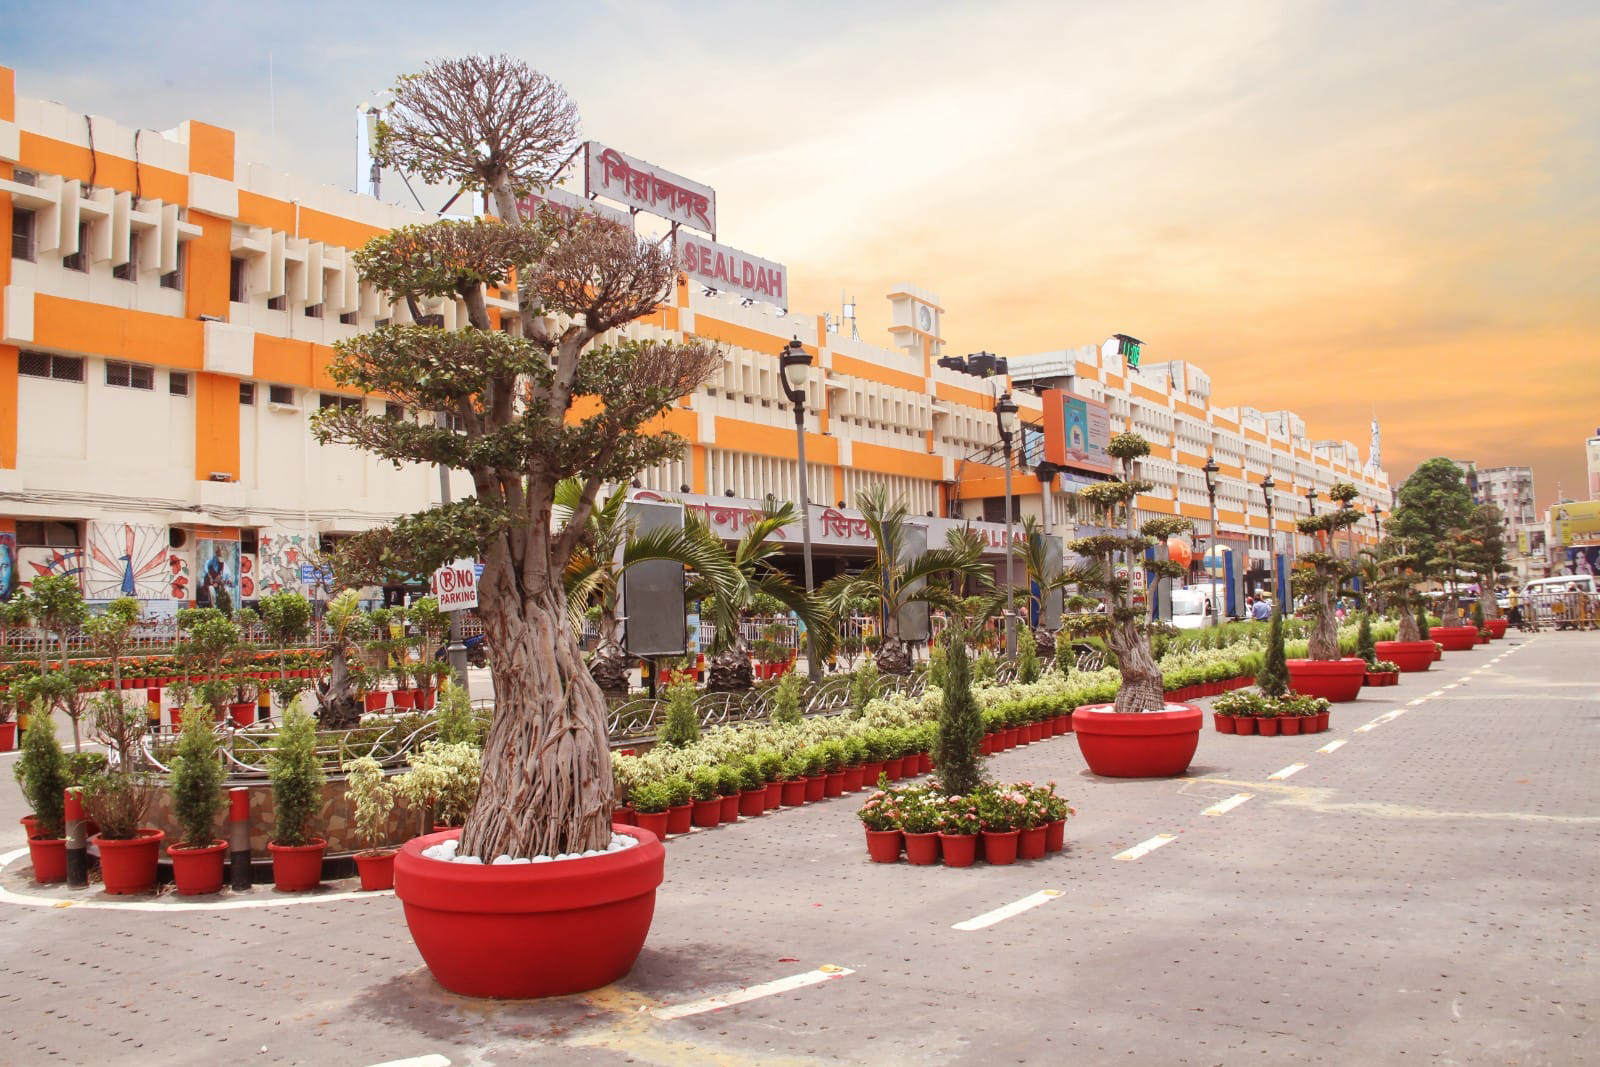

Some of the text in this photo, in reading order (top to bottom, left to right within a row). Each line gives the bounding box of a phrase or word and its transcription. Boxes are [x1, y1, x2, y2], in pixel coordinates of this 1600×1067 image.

[684, 242, 782, 298] SEALDAH
[457, 569, 473, 588] NO
[440, 591, 476, 604] PARKING
